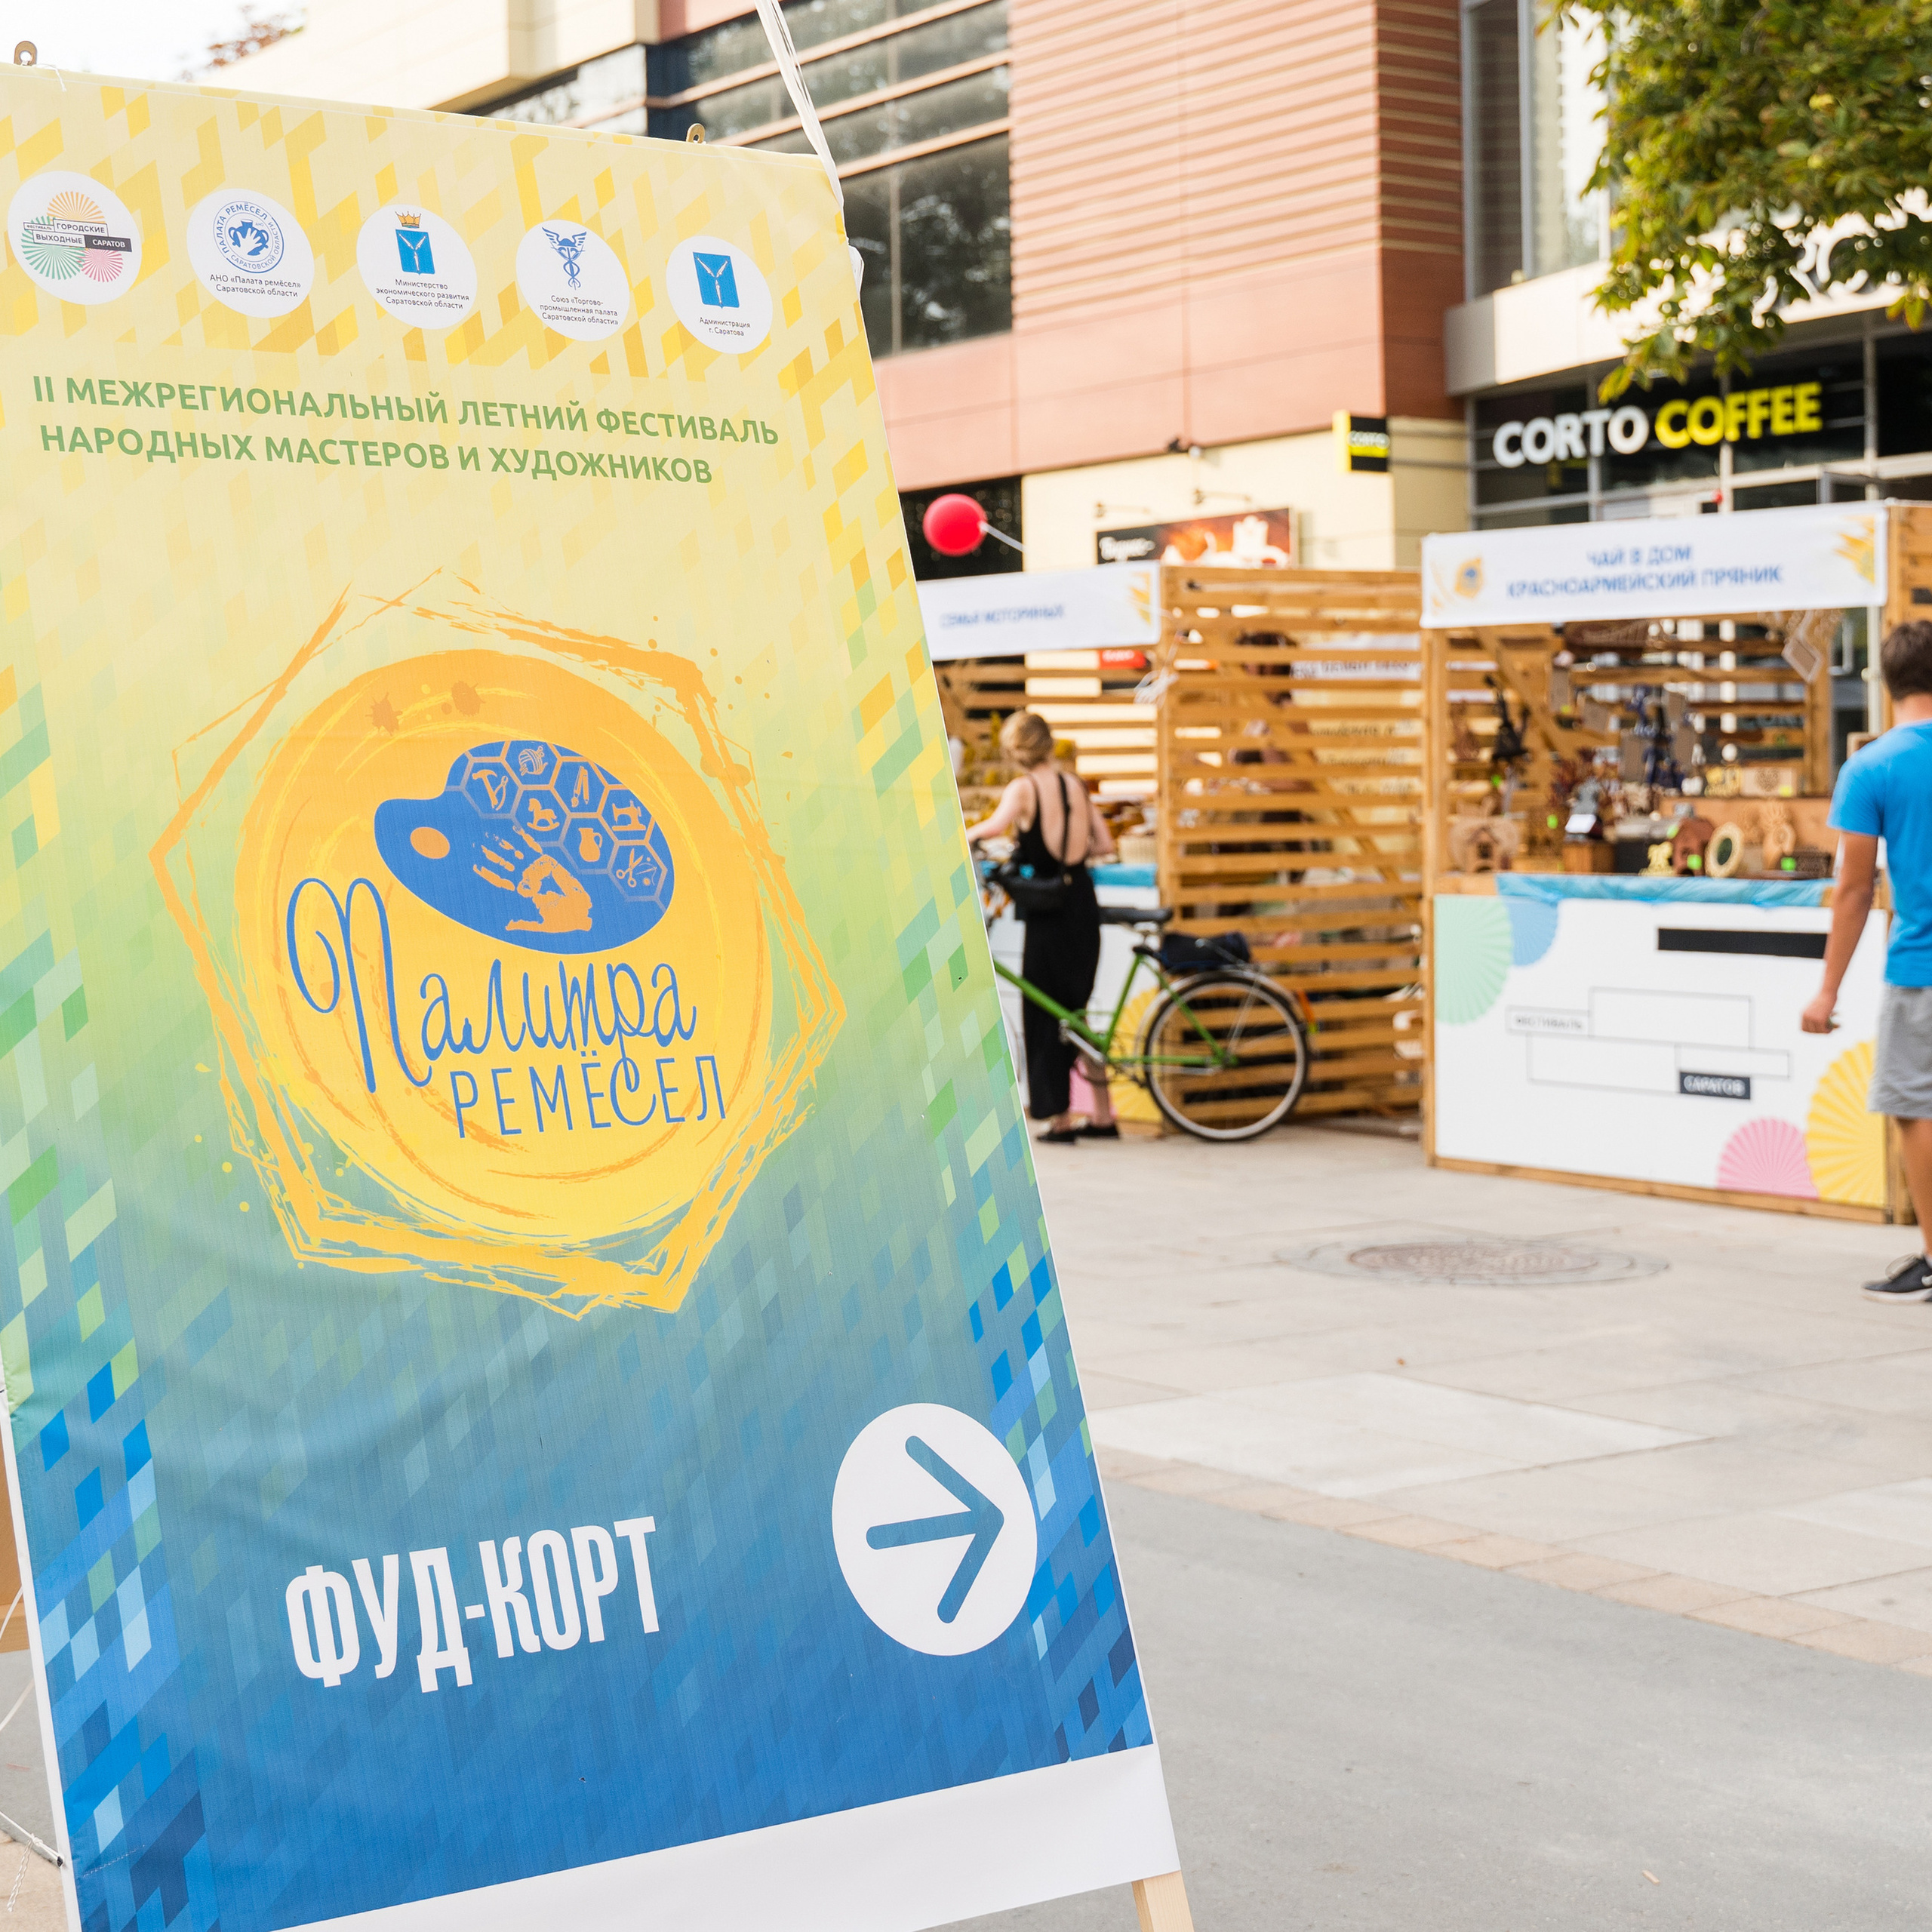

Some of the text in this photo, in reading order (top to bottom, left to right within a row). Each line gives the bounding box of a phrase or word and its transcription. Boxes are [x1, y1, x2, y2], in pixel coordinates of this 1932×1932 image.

[56, 223, 105, 233] ГОРОДСКИЕ
[216, 202, 268, 254] ПАЛАТА РЕМЁСЕЛ
[35, 233, 126, 248] ВЫХОДНЫЕ САРАТОВ
[230, 222, 280, 269] САРАТОВСКОЙ ОБЛАСТИ
[210, 274, 301, 288] АНО «Палата ремёсел»
[395, 278, 448, 290] Министерство
[216, 284, 298, 297] Саратовской области
[376, 288, 469, 301] экономического развития
[386, 296, 463, 309] Саратовской области
[551, 295, 603, 306] Союз «Торгово-
[540, 304, 593, 314] промышленная
[542, 312, 619, 325] Саратовской области»
[700, 317, 751, 328] Администрация
[714, 327, 744, 336] Саратова
[33, 376, 779, 445] II МЕЖРЕГИОНАЛЬНЫЙ ЛЕТНИЙ ФЕСТИВАЛЬ
[1492, 381, 1823, 468] CORTO COFFEE
[40, 425, 712, 484] НАРОДНЫХ МАСТЕРОВ И ХУДОЖНИКОВ
[1646, 545, 1693, 567] ДОМ
[1700, 563, 1783, 588] ПРЯНИК
[287, 878, 698, 1094] Палитра
[450, 1050, 727, 1139] РЕМЁСЕЛ
[285, 1515, 660, 1693] ФУД-КОРТ
